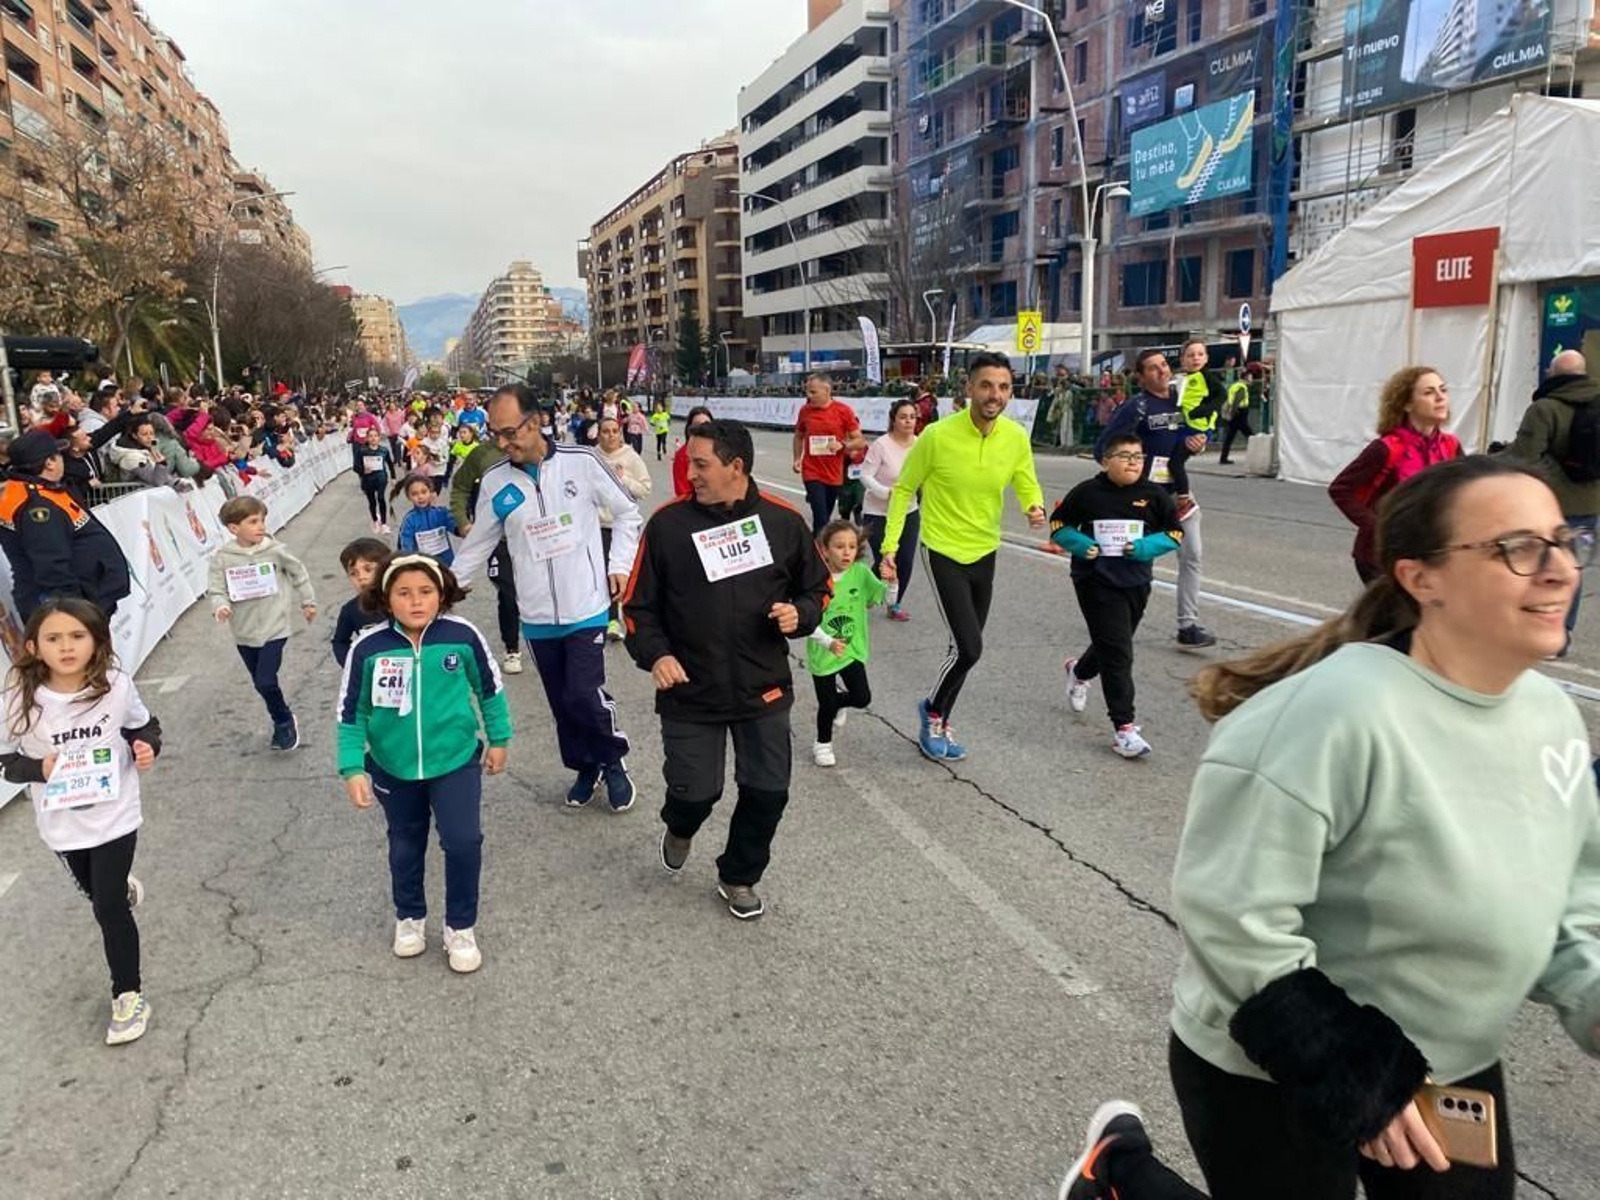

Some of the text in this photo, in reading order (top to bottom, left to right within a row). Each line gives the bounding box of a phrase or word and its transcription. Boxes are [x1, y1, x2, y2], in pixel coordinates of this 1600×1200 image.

[1363, 34, 1400, 55] nuevo
[1210, 49, 1254, 75] CULMIA
[1493, 43, 1544, 69] CULMIA
[1135, 141, 1177, 165] Destino,
[1136, 160, 1175, 180] tu meta
[1217, 175, 1247, 191] CULMIA
[1436, 256, 1473, 282] ELITE
[718, 540, 751, 559] LUIS
[51, 725, 102, 746] IRENA
[70, 776, 91, 790] 287
